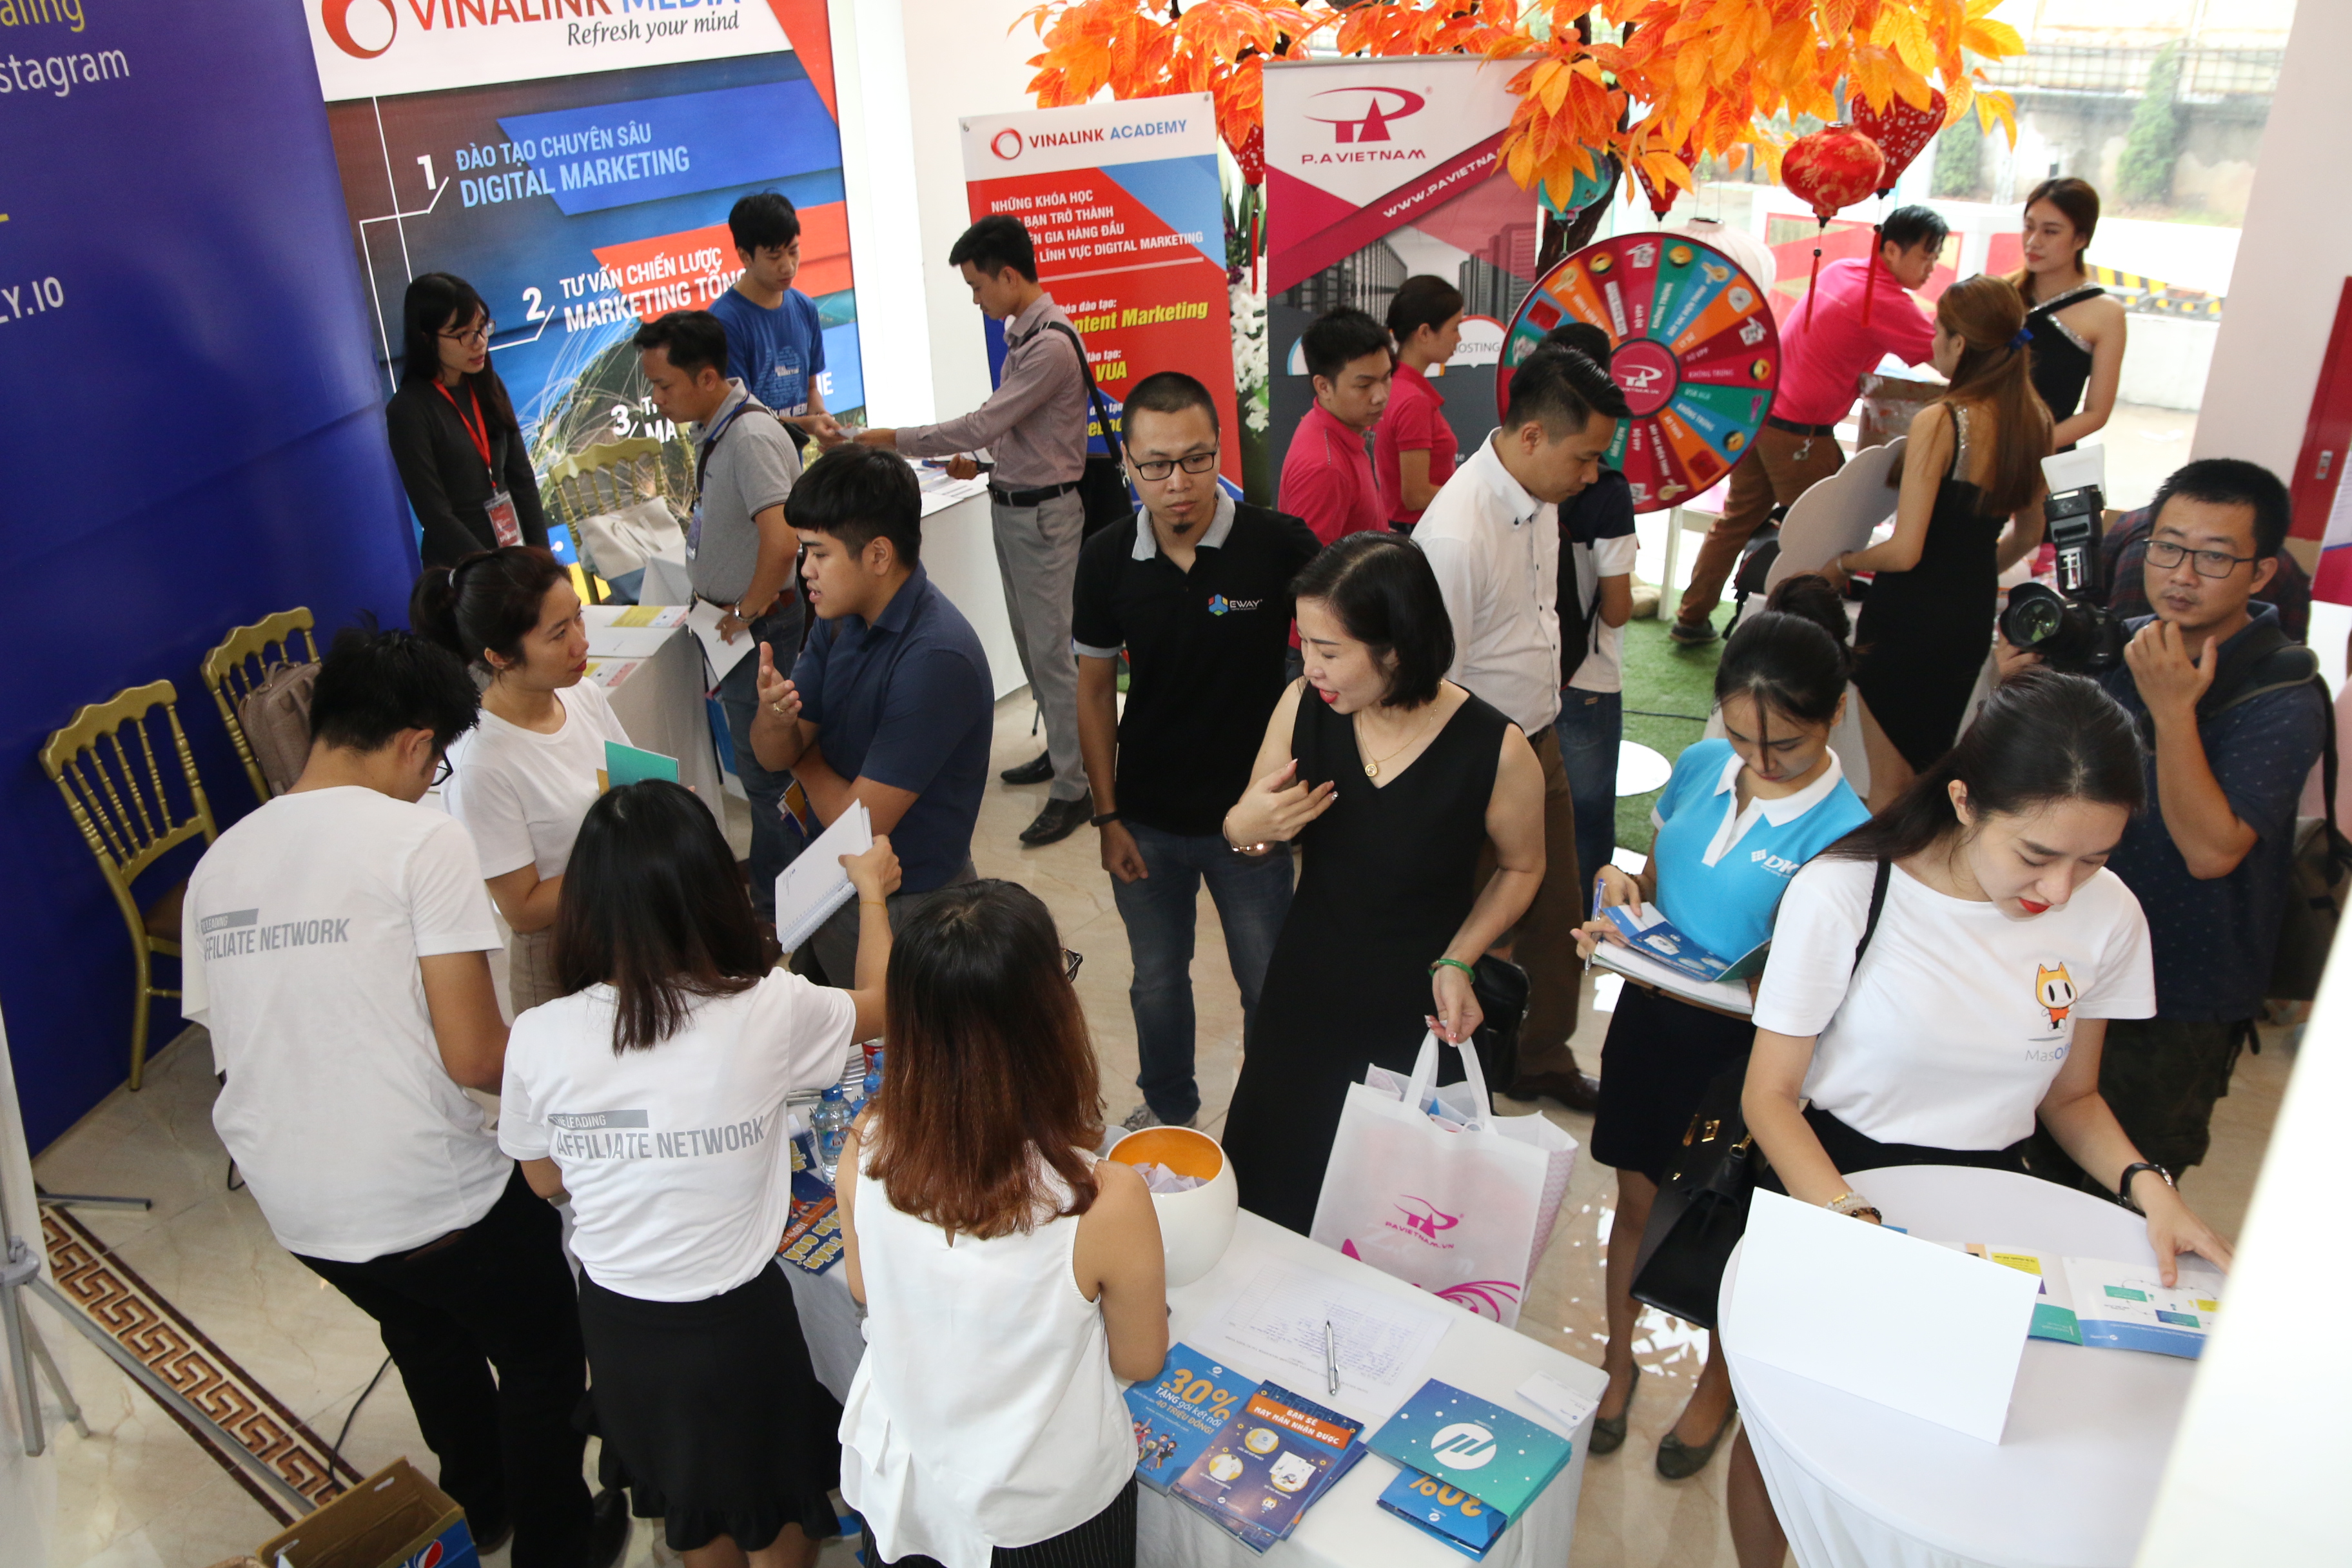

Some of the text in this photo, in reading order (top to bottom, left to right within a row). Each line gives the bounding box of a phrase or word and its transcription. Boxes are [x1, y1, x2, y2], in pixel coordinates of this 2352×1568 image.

[0, 0, 85, 32] aling
[567, 10, 740, 48] Refresh your mind
[0, 50, 130, 97] stagram
[1029, 119, 1188, 149] VINALINK ACADEMY
[417, 121, 652, 191] 1 ĐÀO TẠO CHUYÊN SÂU
[460, 146, 691, 209] DIGITAL MARKETING
[1383, 146, 1502, 218] WWW.PAVIETNA
[991, 190, 1093, 213] NHỮNG KHÓA HỌC
[1024, 206, 1114, 229] BẠN TRỞ THÀNH
[1045, 230, 1065, 244] GIA
[1066, 225, 1099, 240] HÀNG
[1101, 220, 1125, 237] ĐẦU
[1039, 231, 1204, 262] LĨNH VỰC DIGITAL MARKETING
[522, 247, 723, 322] 2 TƯ VẤN CHIẾN LƯỢC
[0, 277, 64, 324] Y.IO
[564, 288, 691, 333] MARKETING
[1060, 299, 1117, 315] hóa đào tạo:
[1074, 302, 1209, 334] ntent Marketing
[1104, 350, 1122, 362] tạo:
[1456, 341, 1501, 354] OSTING
[610, 404, 631, 436] 3
[1230, 600, 1260, 608] EWAY
[206, 916, 228, 932] LEADING
[260, 918, 350, 952] NETWORK
[549, 1114, 606, 1128] THE LEADING
[556, 1132, 652, 1159] AFFILIATE
[656, 1115, 764, 1159] NETWORK
[1155, 1398, 1168, 1409] 40
[1161, 1368, 1239, 1421] 30%
[1176, 1399, 1193, 1413] gói
[1191, 1406, 1208, 1420] kết
[1206, 1413, 1222, 1428] nối
[1253, 1405, 1271, 1418] MAY
